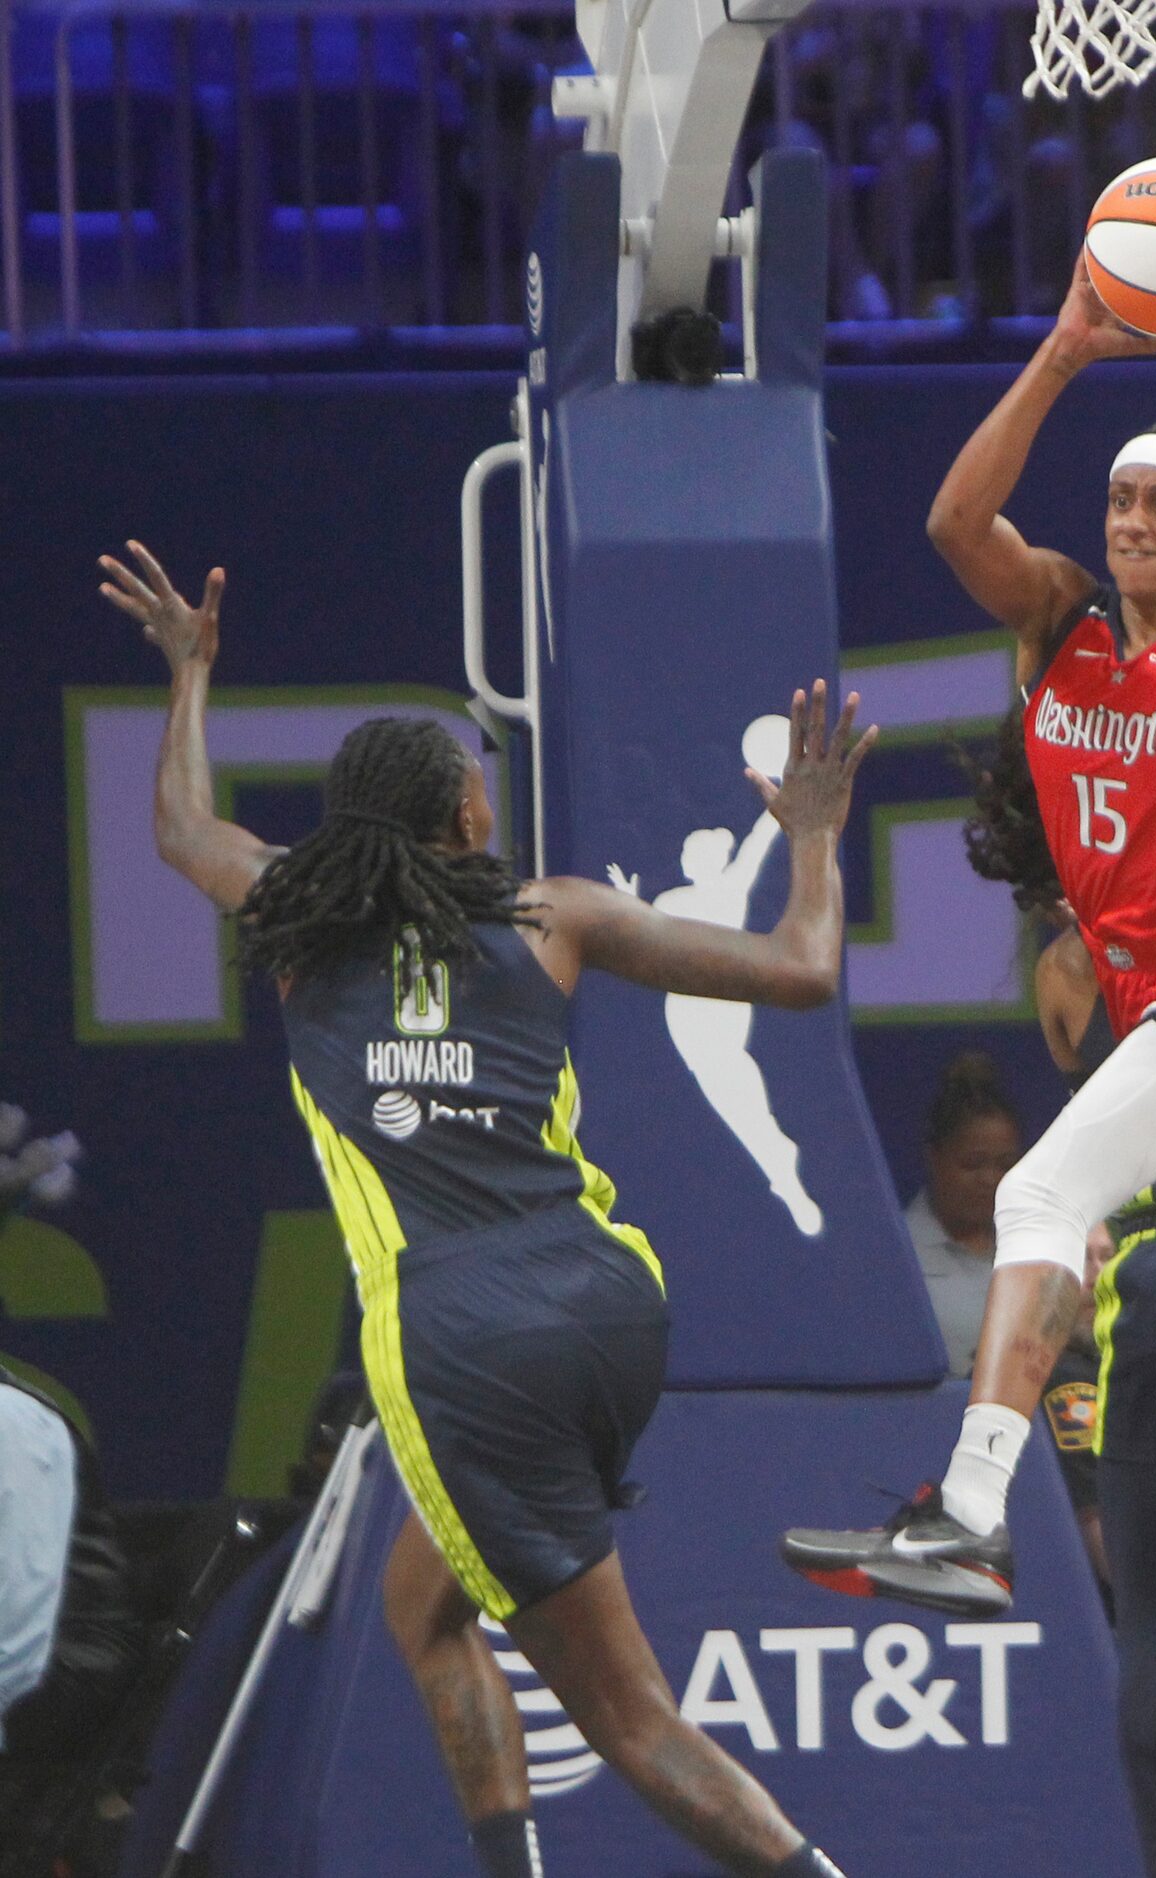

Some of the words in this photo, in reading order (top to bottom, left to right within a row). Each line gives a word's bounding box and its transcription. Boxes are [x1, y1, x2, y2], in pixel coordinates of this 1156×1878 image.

[1071, 773, 1128, 854] 15
[366, 1040, 474, 1085] HOWARD
[679, 1621, 1042, 1751] AT&T
